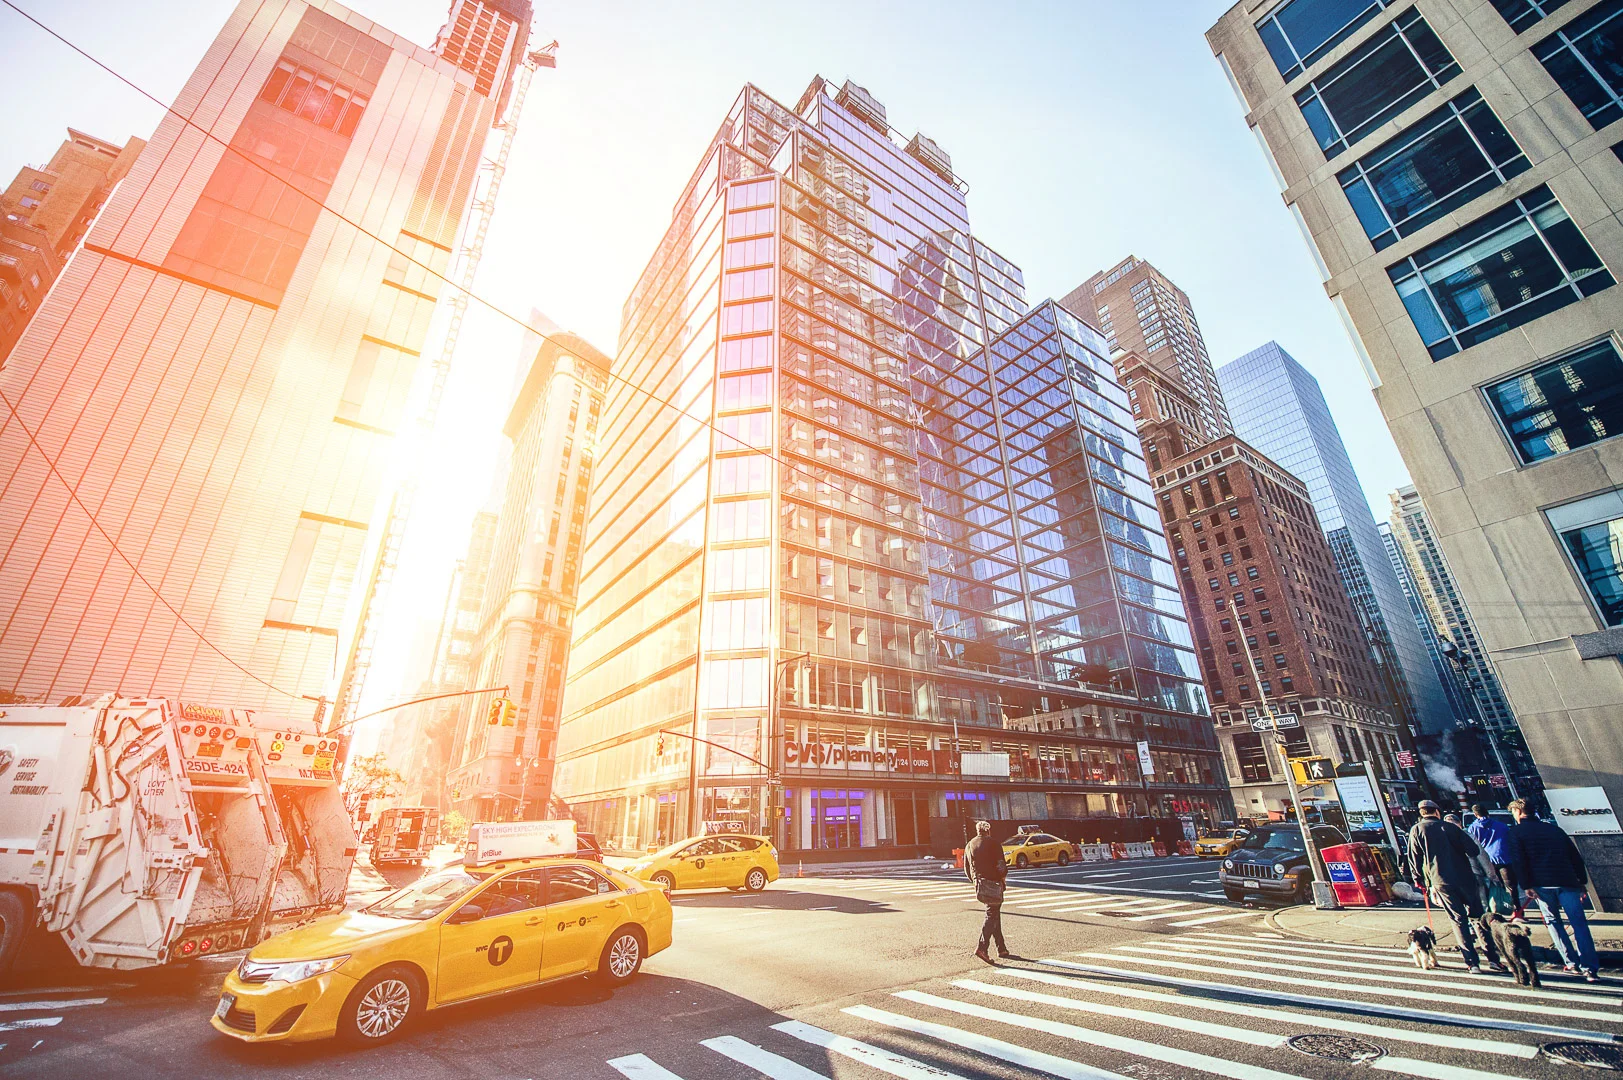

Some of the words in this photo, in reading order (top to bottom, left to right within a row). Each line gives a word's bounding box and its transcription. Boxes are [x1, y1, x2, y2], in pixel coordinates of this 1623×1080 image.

[193, 706, 222, 717] SLOW
[785, 741, 897, 768] CVS/pharmacy
[18, 759, 40, 768] SAFETY
[186, 761, 245, 774] 25DE-424
[13, 772, 37, 781] SERVICE
[10, 785, 49, 796] SUSTAINABILITY
[1560, 808, 1613, 817] Steelcase
[482, 827, 494, 835] SKY
[495, 826, 512, 834] HIGH
[481, 850, 502, 859] jetBlue
[475, 945, 488, 953] NYC
